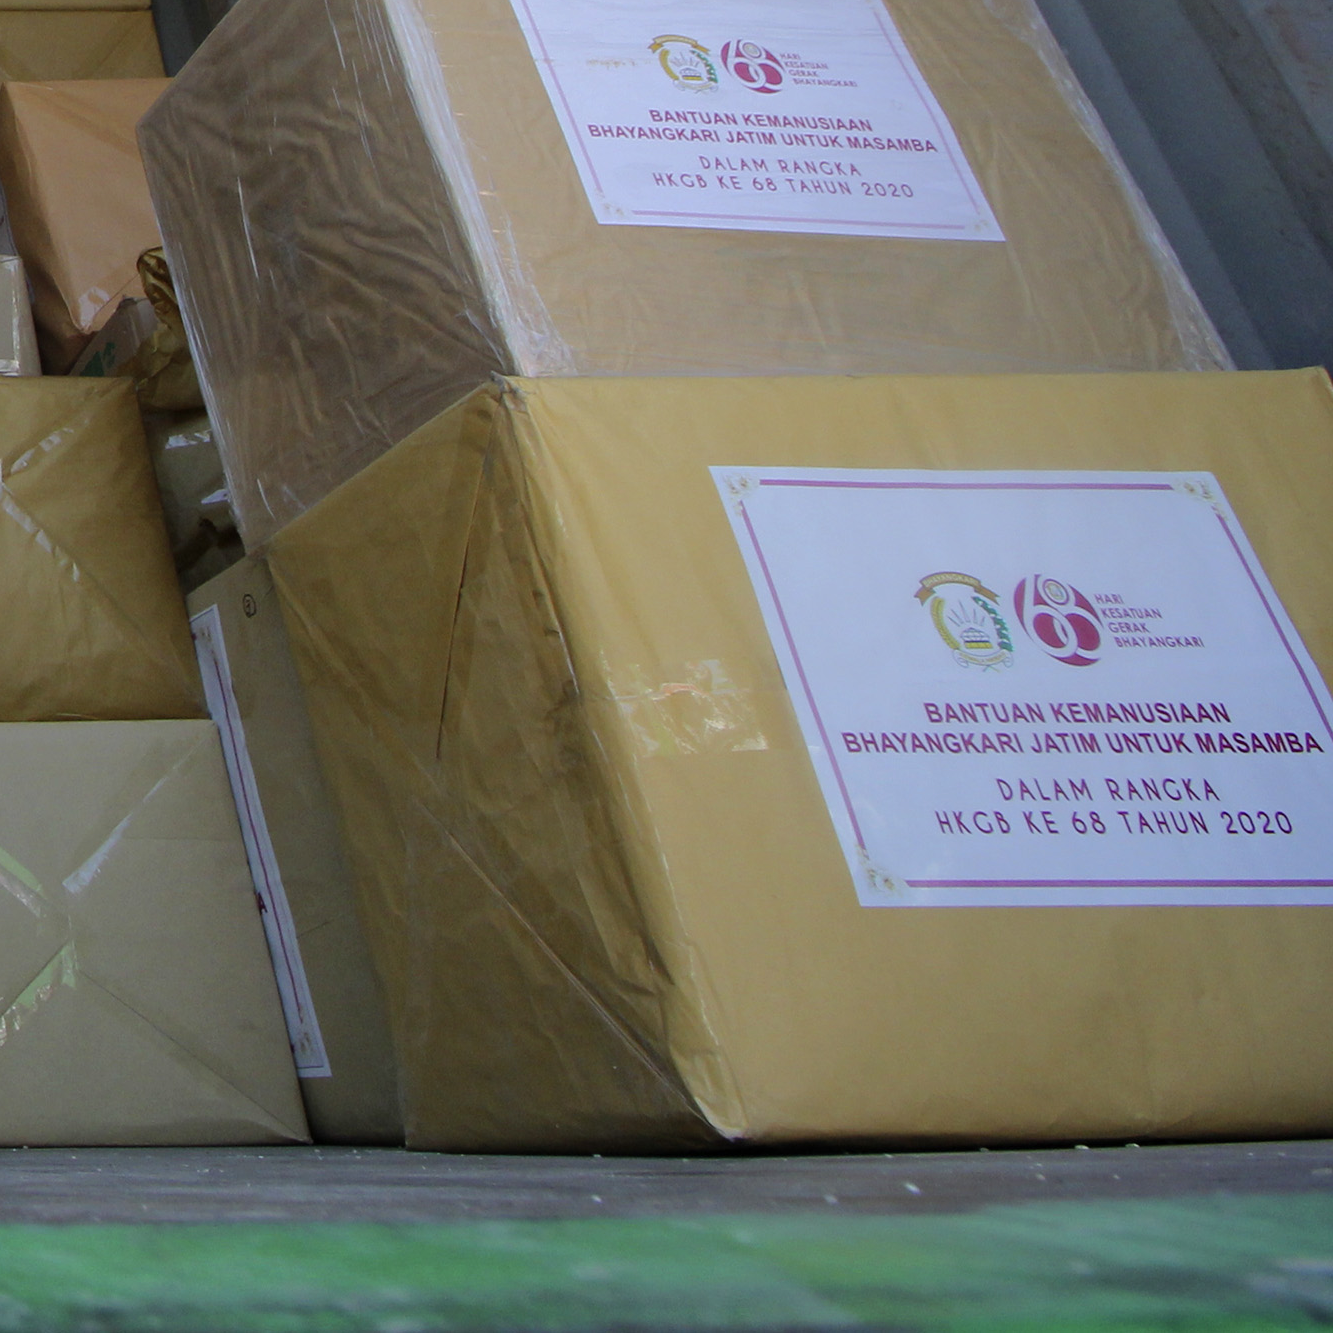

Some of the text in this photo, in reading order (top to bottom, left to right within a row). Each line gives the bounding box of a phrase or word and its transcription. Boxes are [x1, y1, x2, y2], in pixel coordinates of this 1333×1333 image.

[649, 109, 873, 132] BANTUAN KEMANUSIAAN
[588, 124, 938, 153] BHAYANGKARI JATIM UNTUK MASAMBA
[698, 155, 861, 177] DALAM RANGKA
[652, 172, 914, 198] HKGB KE 68 TAHUN 2020
[1094, 593, 1124, 605] HARI
[1100, 608, 1163, 619] KESATUAN
[1107, 622, 1151, 633] GERAK
[1114, 636, 1205, 648] BHAYANGKARI
[923, 702, 1231, 723] BANTUAN KEMANUSIAAN
[841, 732, 1324, 753] BHAYANGKARI JATIM UNTUK MASAMBA
[995, 778, 1220, 801] DALAM RANGKA
[934, 811, 1293, 834] HKGB KE 68 TAHUN 2020
